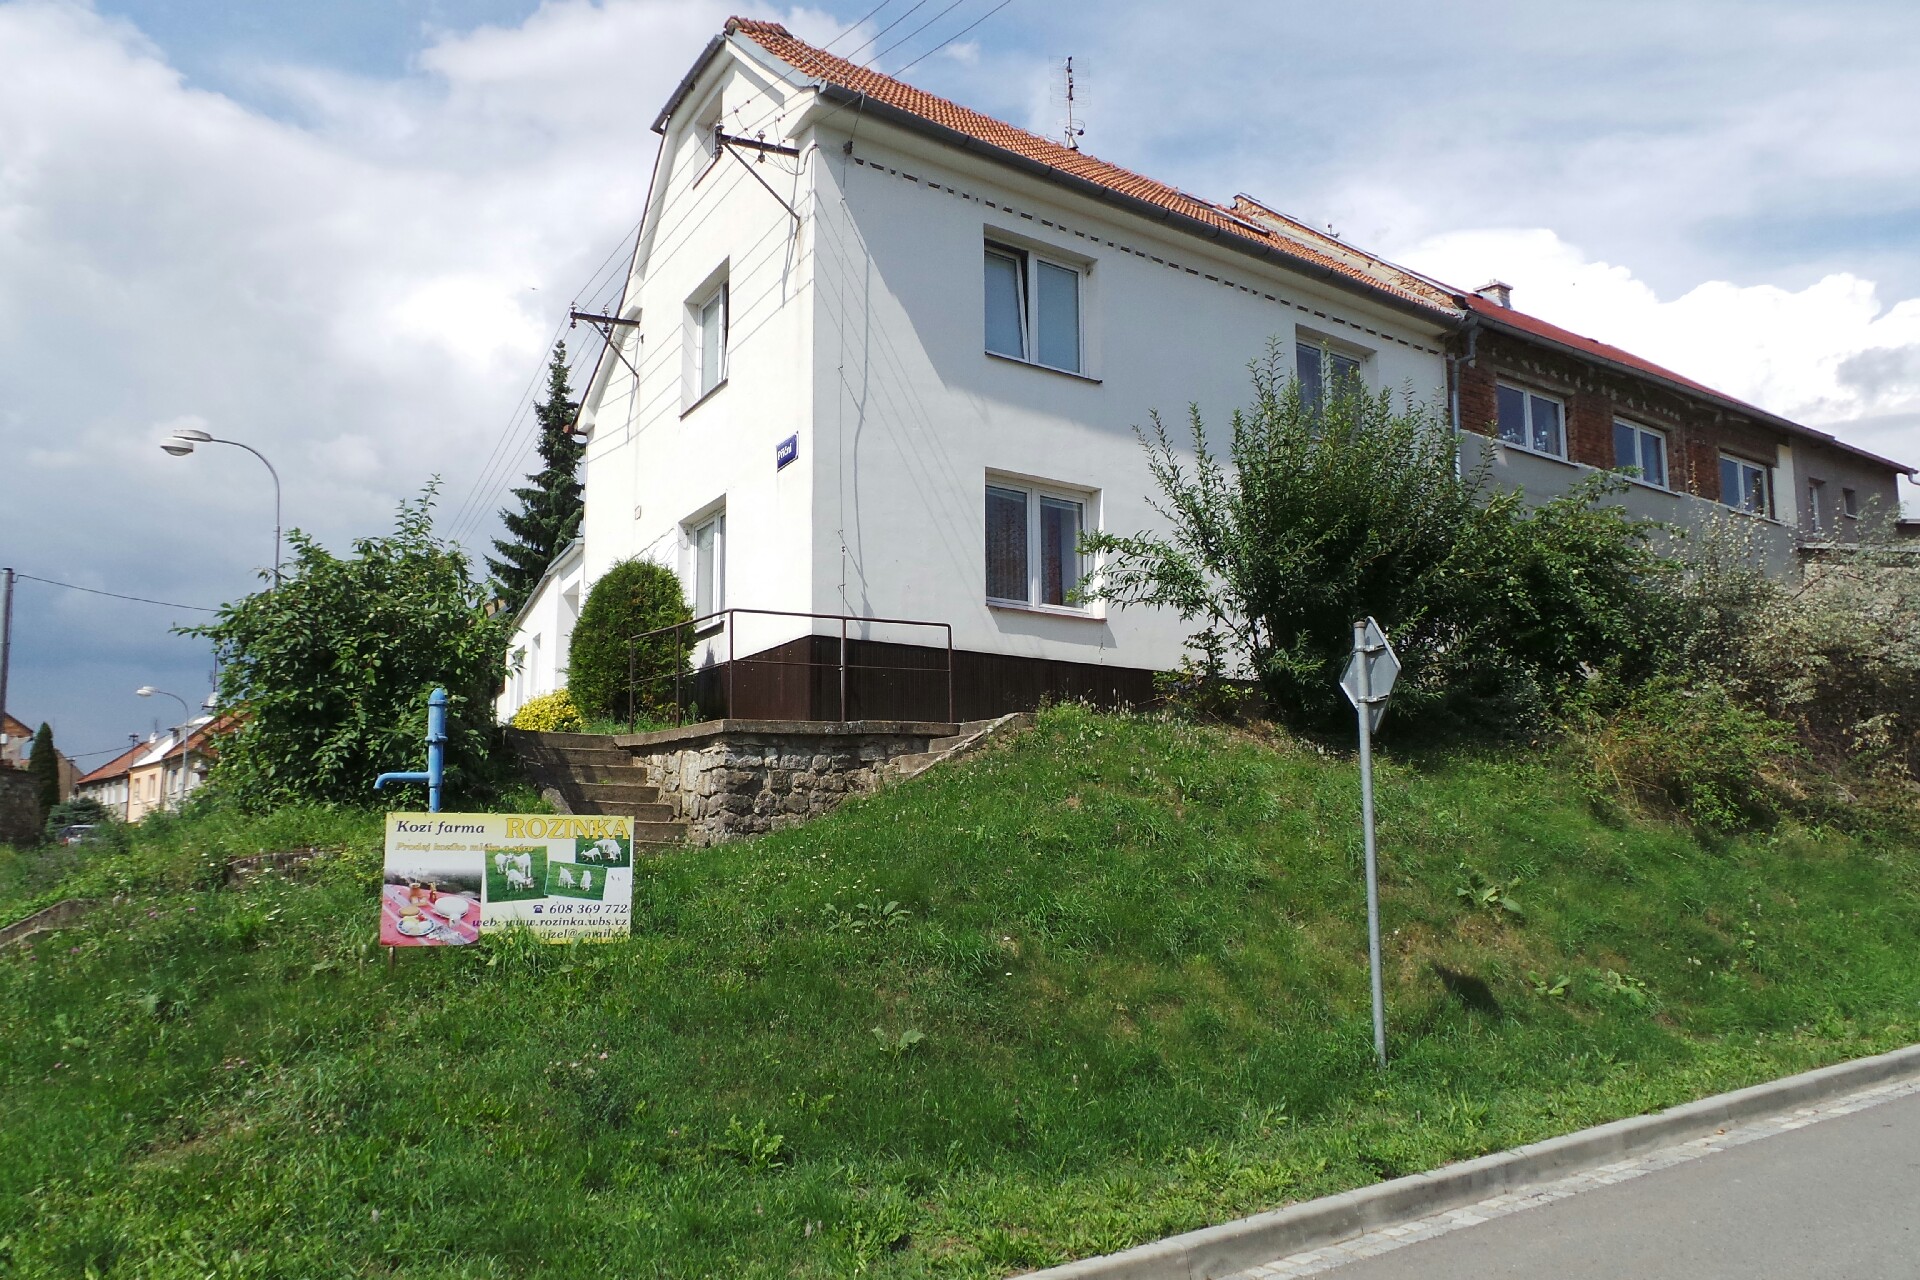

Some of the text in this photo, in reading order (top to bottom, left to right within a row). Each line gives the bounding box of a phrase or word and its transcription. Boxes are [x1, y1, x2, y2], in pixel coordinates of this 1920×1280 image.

[396, 817, 630, 839] Kozí farma ROZINKA
[549, 904, 628, 914] 608 369 772
[472, 915, 628, 927] web: www.rozinka.wbs.cz
